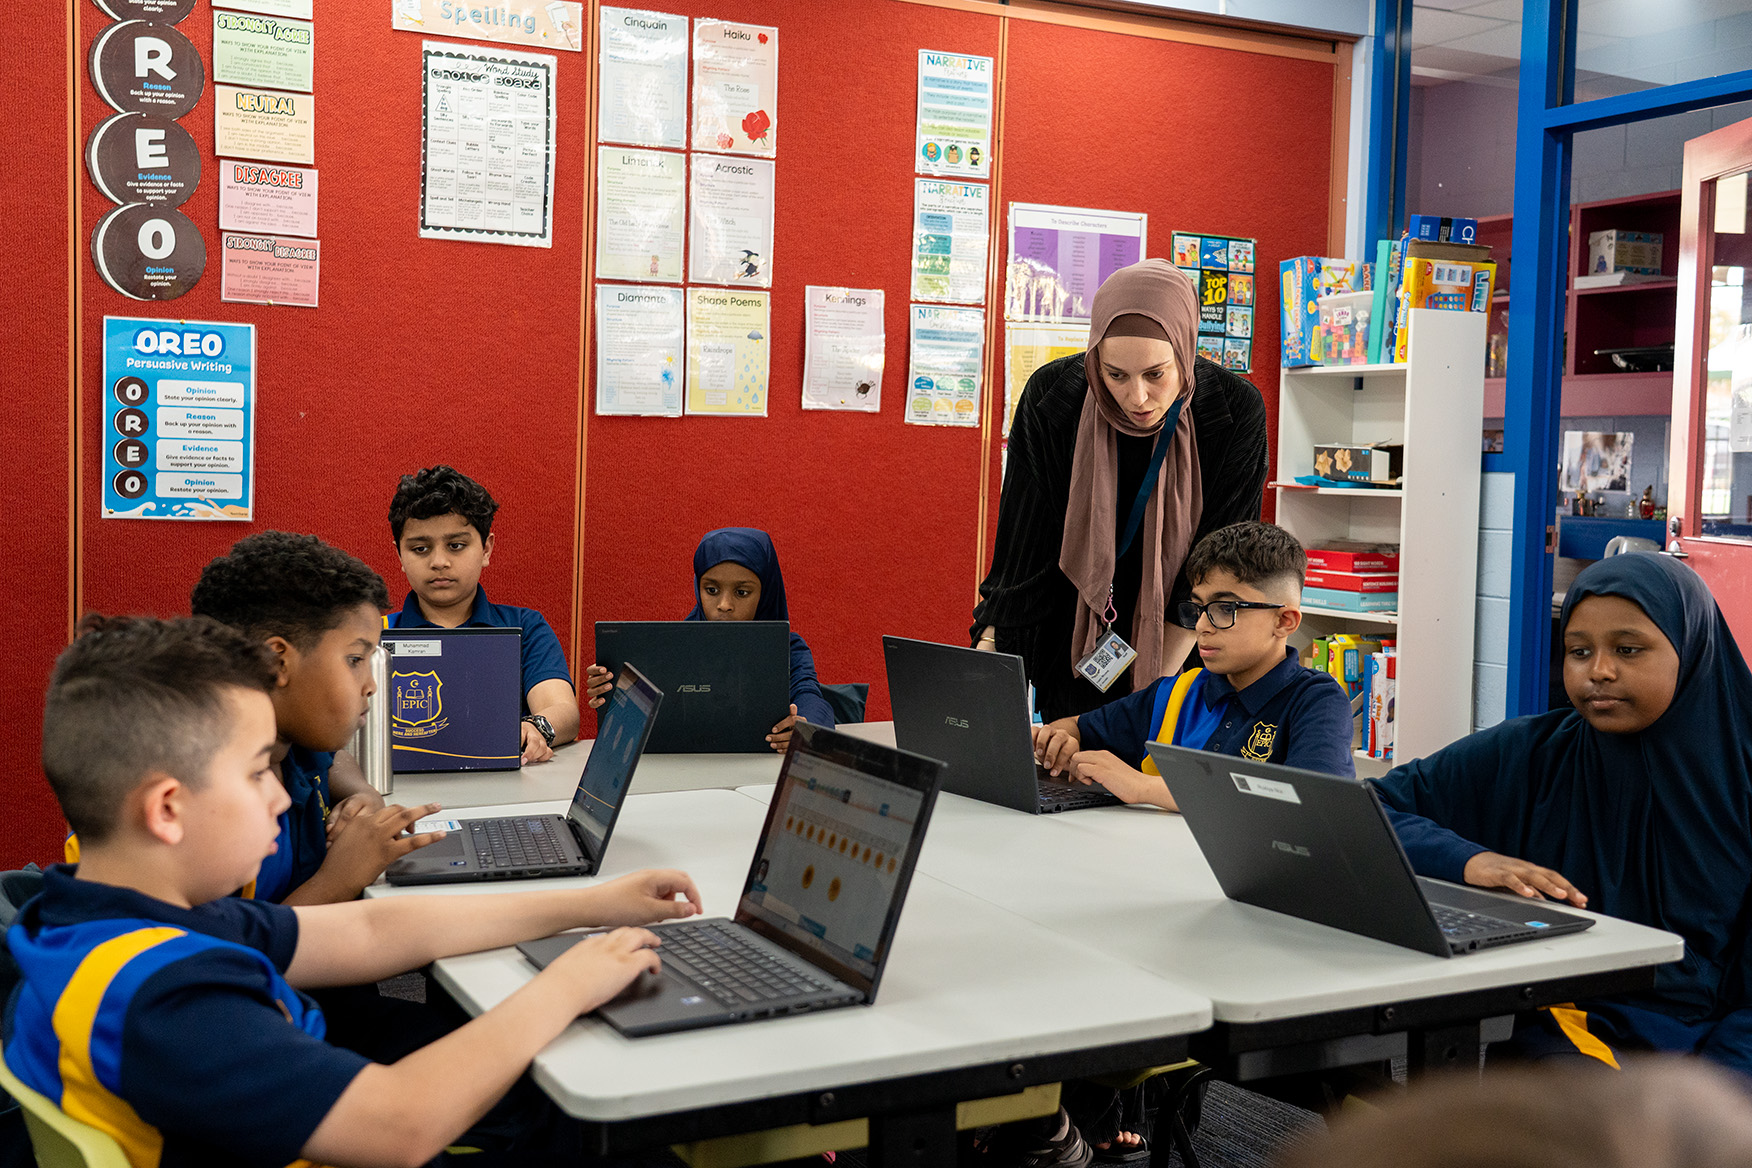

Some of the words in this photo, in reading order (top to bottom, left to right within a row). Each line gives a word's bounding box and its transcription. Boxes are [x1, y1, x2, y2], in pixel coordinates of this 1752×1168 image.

[441, 1, 536, 34] Spelling
[623, 16, 668, 31] Cinquain
[218, 14, 276, 35] STRONGLY
[274, 27, 310, 44] AGREE
[724, 29, 751, 41] Haiku
[135, 37, 177, 81] R
[927, 55, 986, 71] NARRATIVE
[512, 67, 539, 81] Study
[143, 82, 172, 91] Reason
[236, 92, 295, 116] NEUTRAL
[136, 128, 169, 168] E
[234, 165, 302, 189] DISAGREE
[715, 163, 754, 176] Acrostic
[923, 183, 982, 198] NARRATIVE
[138, 219, 176, 260] O
[227, 236, 276, 252] STRONGLY
[274, 246, 317, 261] DISAGREE
[146, 266, 174, 275] Opinion
[1206, 277, 1227, 289] TOP
[1203, 287, 1226, 306] 10
[1470, 270, 1490, 313] LINE
[697, 295, 728, 306] Shape
[730, 297, 762, 307] Poems
[825, 294, 867, 306] Kennings
[134, 328, 224, 358] OREO
[127, 358, 188, 370] Persuasive
[191, 361, 232, 374] Writing
[126, 384, 142, 401] O
[186, 387, 216, 395] Opinion
[125, 415, 142, 432] R
[127, 446, 140, 462] E
[125, 476, 140, 493] O
[677, 684, 712, 693] ASUS
[402, 700, 428, 709] EPIC
[945, 715, 970, 729] ASUS
[1272, 840, 1311, 857] ASUS
